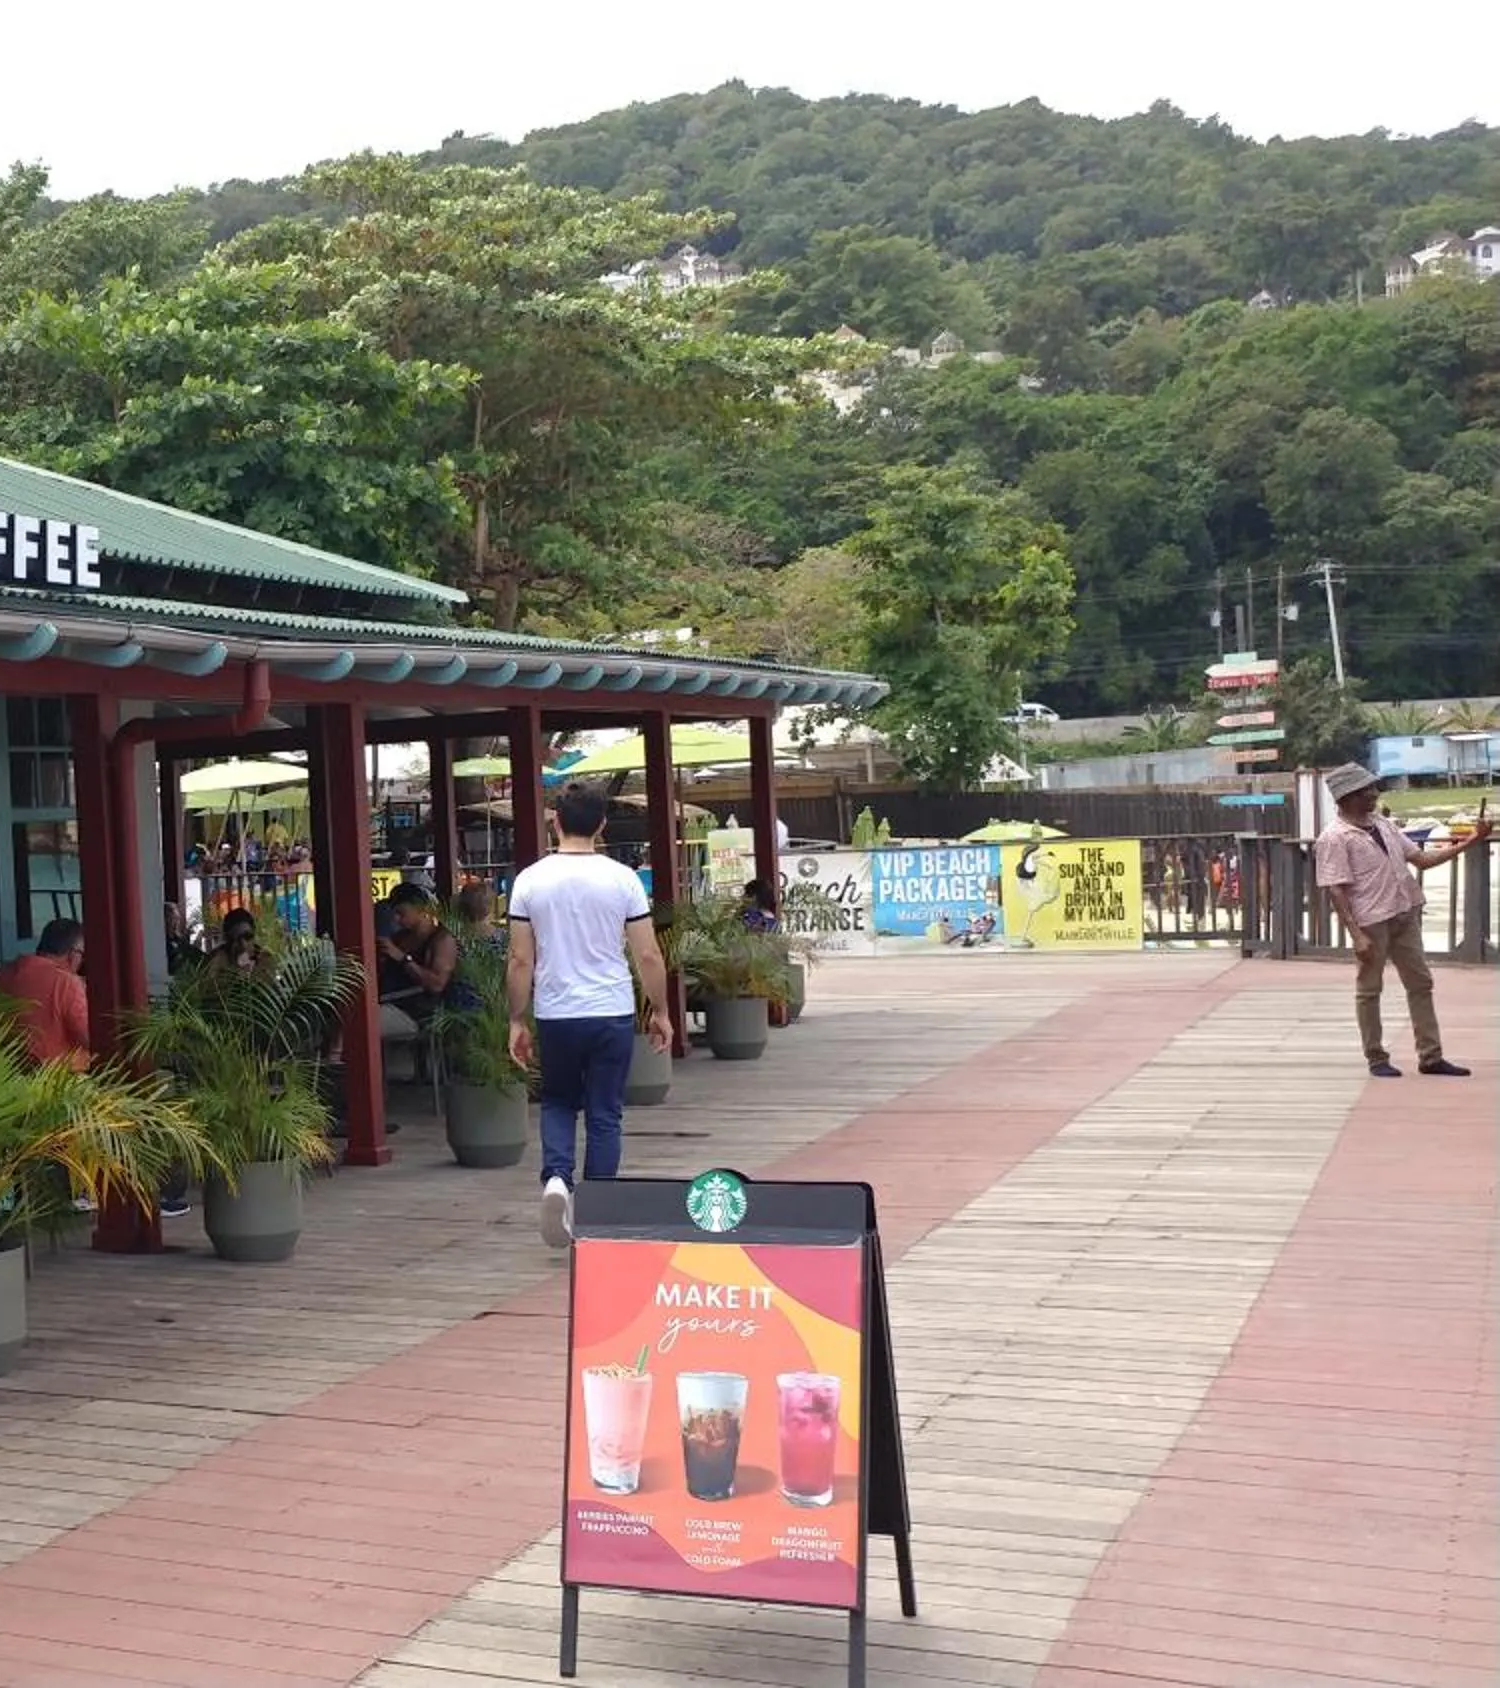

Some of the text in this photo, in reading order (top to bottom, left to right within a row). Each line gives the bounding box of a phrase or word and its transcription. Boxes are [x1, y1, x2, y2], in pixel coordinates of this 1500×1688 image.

[879, 849, 990, 876] VIP BEACH
[1079, 847, 1104, 862] THE
[1074, 877, 1114, 892] AND A
[1065, 891, 1123, 907] DRINK IN
[777, 907, 865, 932] TRANCE
[1064, 905, 1125, 921] MY HAND
[654, 1282, 773, 1311] MAKE IT
[657, 1316, 763, 1354] yours
